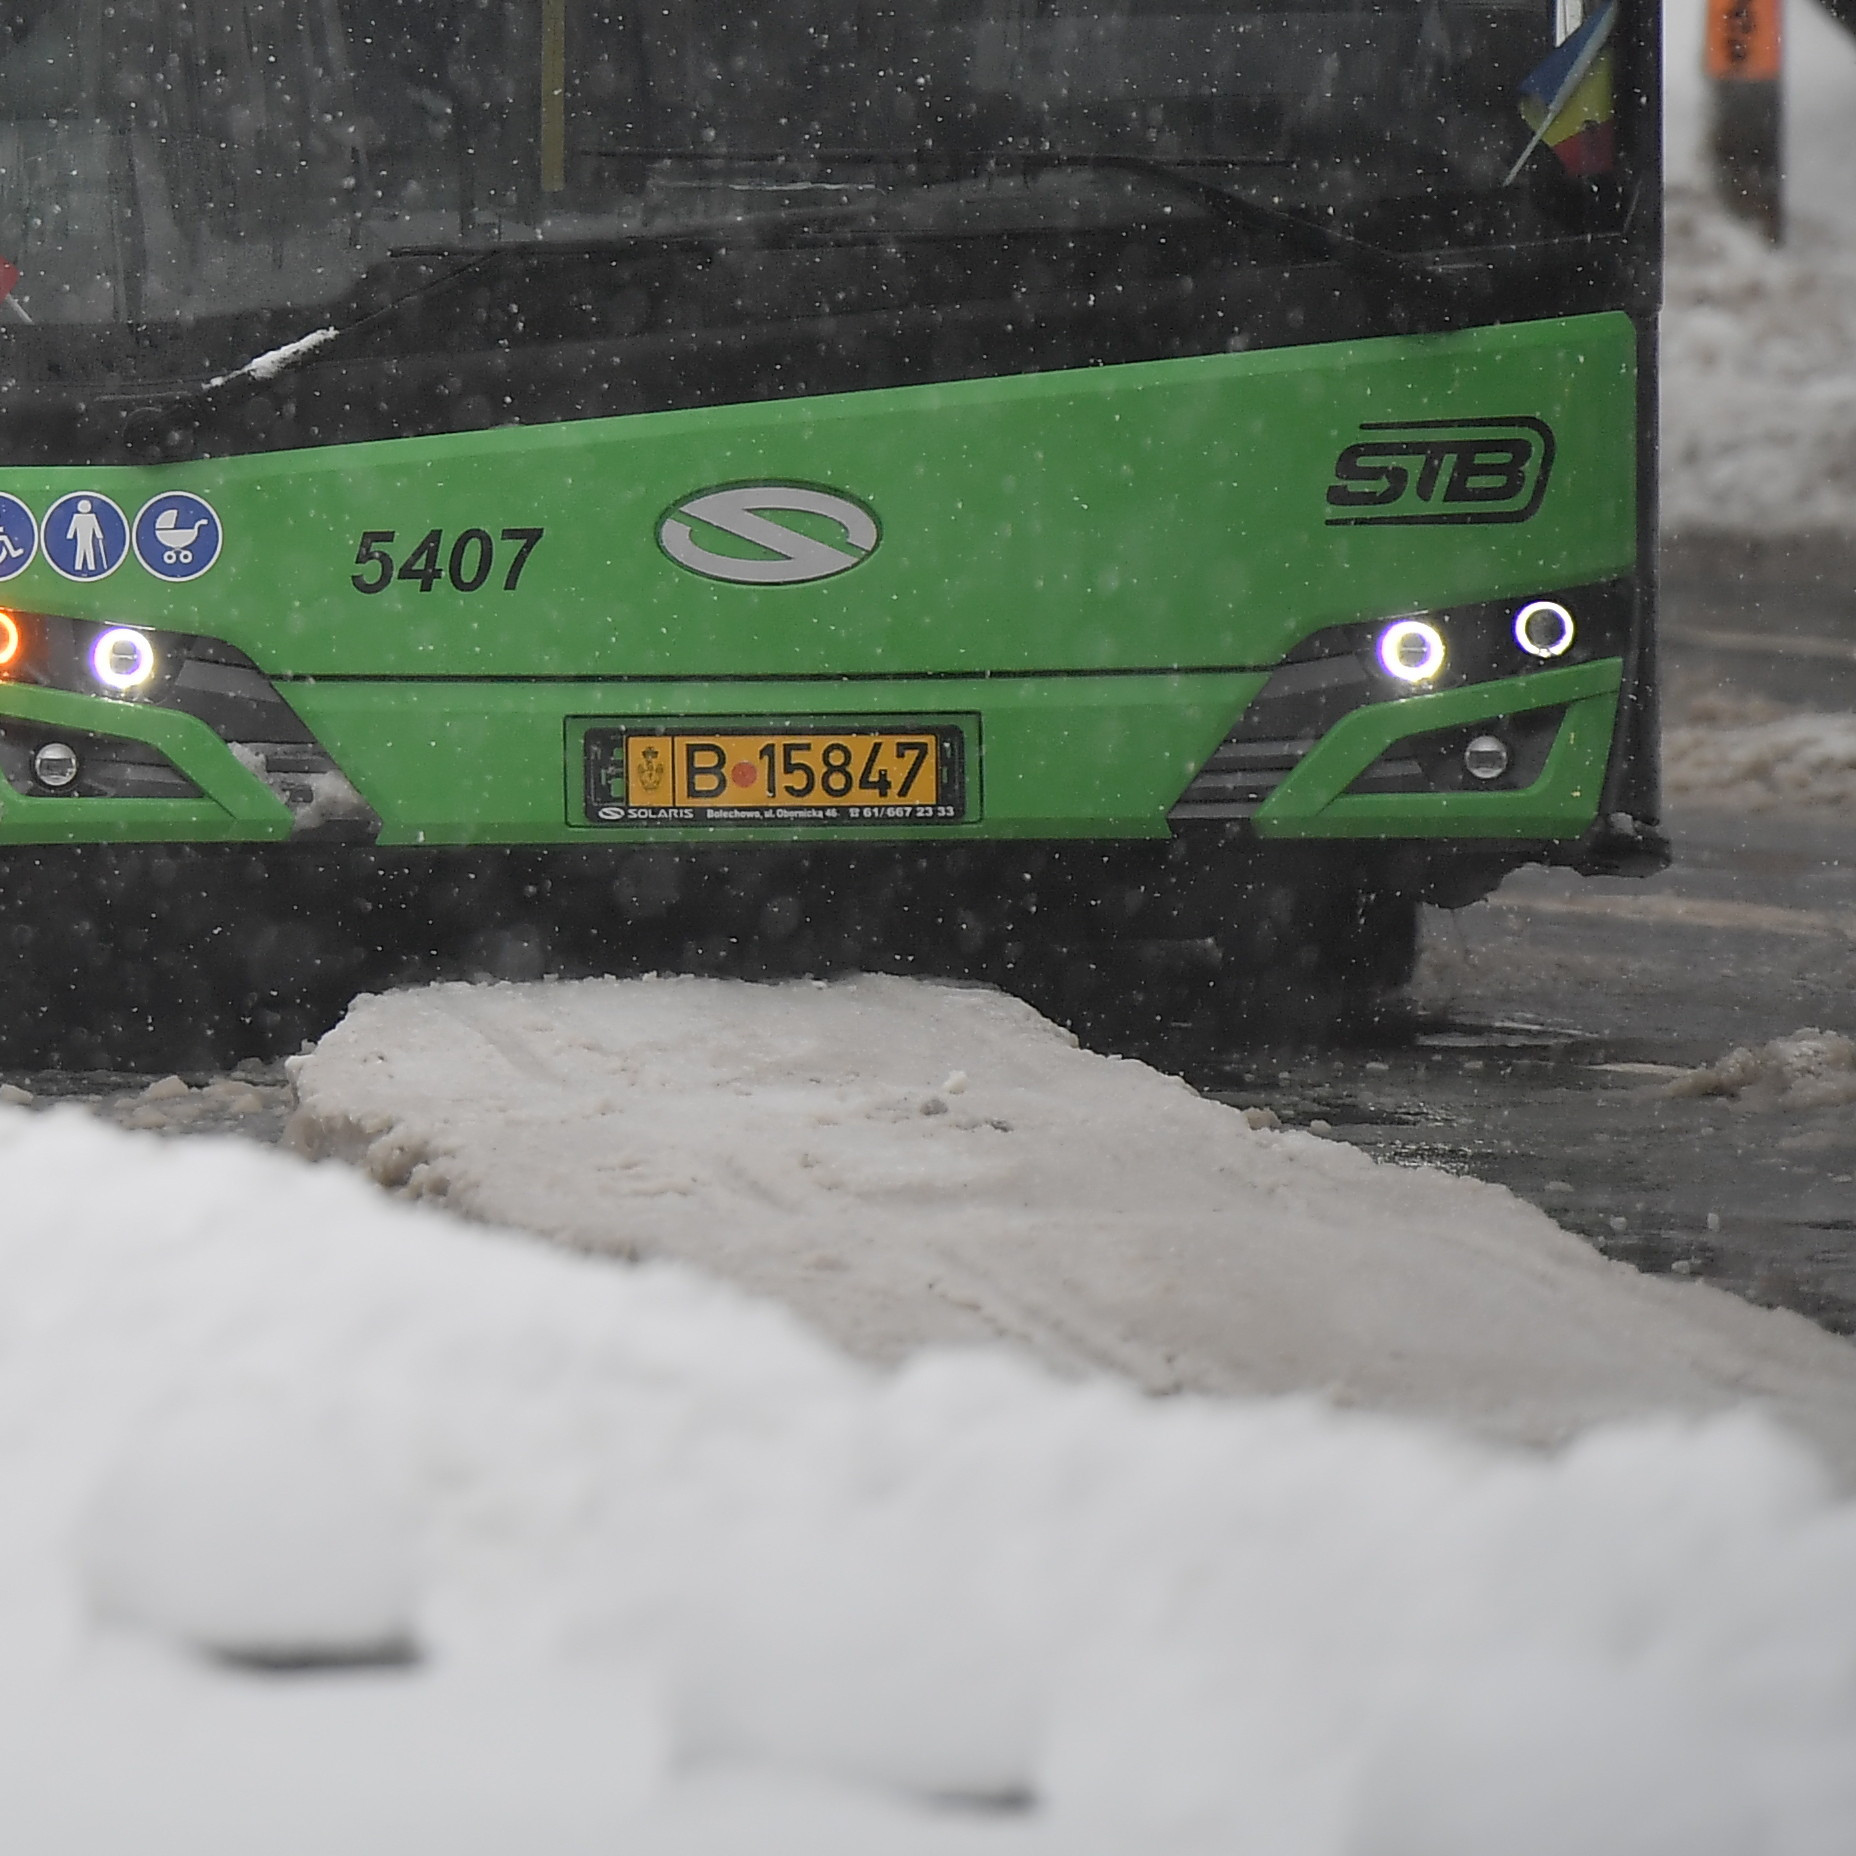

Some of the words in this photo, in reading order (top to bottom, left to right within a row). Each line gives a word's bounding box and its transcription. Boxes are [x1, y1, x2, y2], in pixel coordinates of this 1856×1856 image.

[1326, 438, 1536, 507] STB
[350, 528, 545, 594] 5407
[686, 743, 727, 798] B
[759, 742, 929, 798] 15847
[627, 808, 694, 819] SOLARIS
[915, 807, 934, 817] 23
[936, 806, 955, 816] 33
